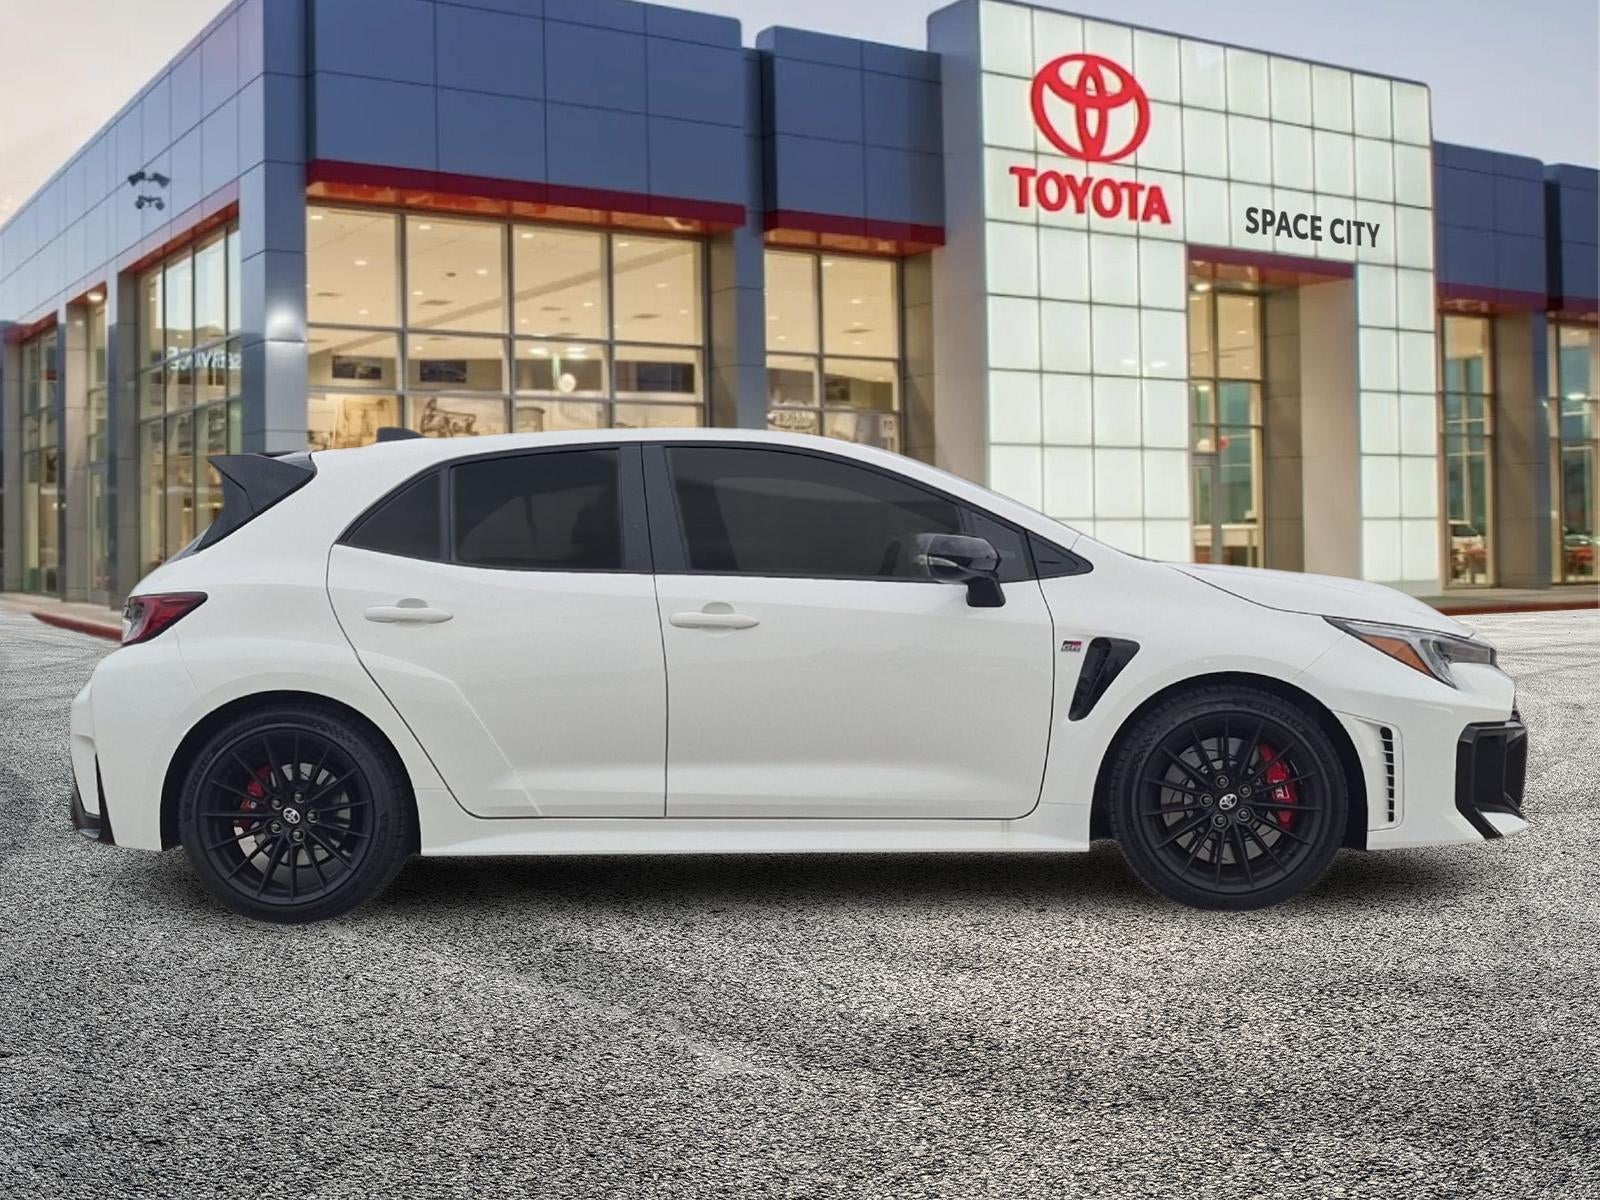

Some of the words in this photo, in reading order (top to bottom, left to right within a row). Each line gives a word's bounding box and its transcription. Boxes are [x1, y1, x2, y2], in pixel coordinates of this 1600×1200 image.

[1009, 166, 1171, 224] TOYOTA
[1245, 207, 1323, 242] SPACE
[1329, 218, 1381, 248] CITY
